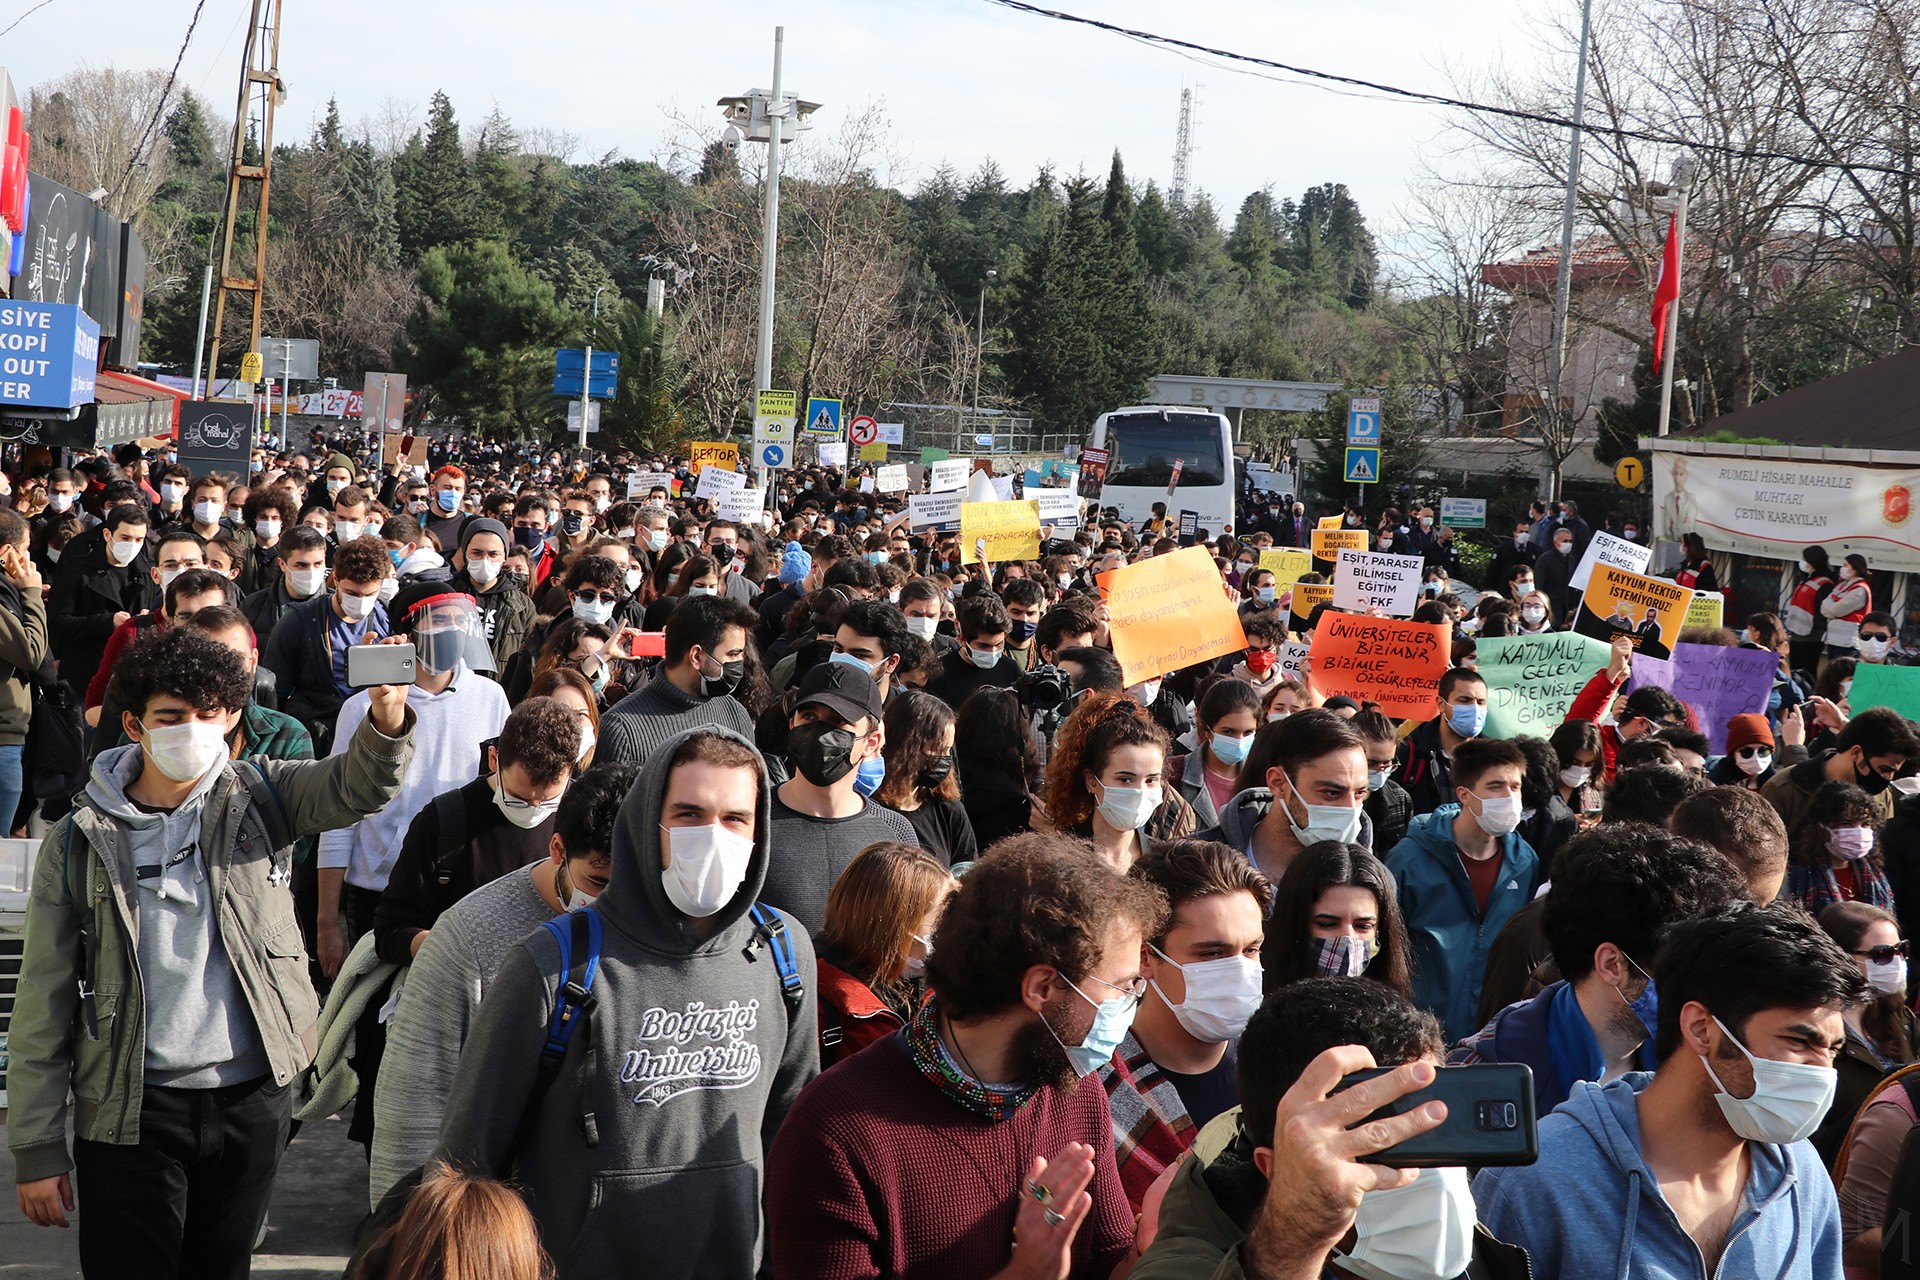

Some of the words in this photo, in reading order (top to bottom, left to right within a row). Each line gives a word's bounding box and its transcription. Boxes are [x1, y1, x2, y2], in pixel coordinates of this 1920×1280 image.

[1, 307, 52, 329] SİYE
[4, 358, 50, 377] OUT
[0, 381, 31, 399] ER
[760, 399, 794, 407] ŞANTİYE
[207, 428, 229, 438] mahal
[768, 424, 782, 433] 20
[1355, 414, 1373, 436] D
[711, 469, 737, 479] KAYYUM
[1624, 465, 1636, 481] T
[1718, 468, 1759, 480] RUMELİ
[1761, 471, 1796, 485] HİSARI
[1798, 475, 1853, 489] MAHALLE
[721, 503, 762, 511] İSTEMİYORUZ
[1754, 490, 1805, 506] MUHTARI
[1734, 507, 1767, 521] ÇETİN
[1767, 510, 1828, 527] KARAYILAN
[1324, 532, 1344, 540] MELİH
[1595, 535, 1616, 552] EŞİT,
[1618, 543, 1649, 562] PARASIZ
[1260, 554, 1287, 570] KABUL
[1342, 552, 1369, 566] EŞİT,
[1371, 557, 1419, 569] PARASIZ
[1598, 551, 1635, 572] BİLİMSEL
[1353, 567, 1404, 581] BİLİMSEL
[1303, 587, 1328, 595] KAYYUM
[1357, 580, 1397, 593] EĞİTİM
[1606, 570, 1647, 591] KAYYUM
[1649, 582, 1683, 602] REKTÖR
[1369, 596, 1393, 607] FKF
[1609, 583, 1673, 613] İSTEMİYORUZ!
[1111, 610, 1137, 630] eden
[1329, 619, 1438, 651] ÜNİVERSİTELER
[1355, 640, 1430, 664] BİZİMDİR
[1498, 638, 1587, 666] KAYYUMLA
[1122, 660, 1146, 678] Okan
[1323, 655, 1389, 672] BİZİMLE
[1522, 661, 1584, 681] GELEN
[1494, 679, 1585, 709] DİRENİŞLE
[1517, 700, 1567, 724] GİDER
[639, 999, 760, 1045] Boğaziçi
[620, 1041, 761, 1083] University
[651, 1086, 671, 1099] 1863
